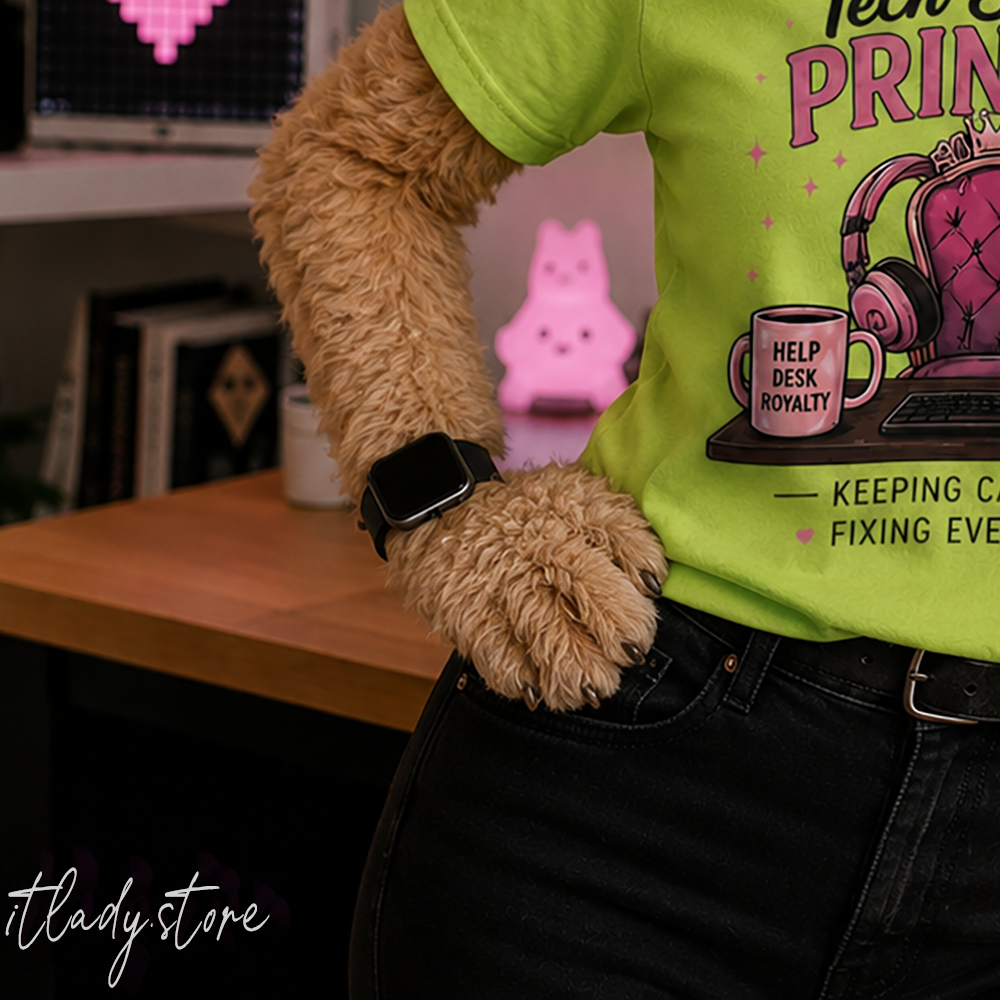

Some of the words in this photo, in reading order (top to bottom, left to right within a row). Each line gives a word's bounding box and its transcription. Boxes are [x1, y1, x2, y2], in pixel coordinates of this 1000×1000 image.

[772, 340, 821, 364] HELP
[772, 367, 818, 390] DESK
[760, 393, 831, 415] ROYALTY
[833, 476, 962, 507] KEEPING
[830, 518, 931, 547] FIXING
